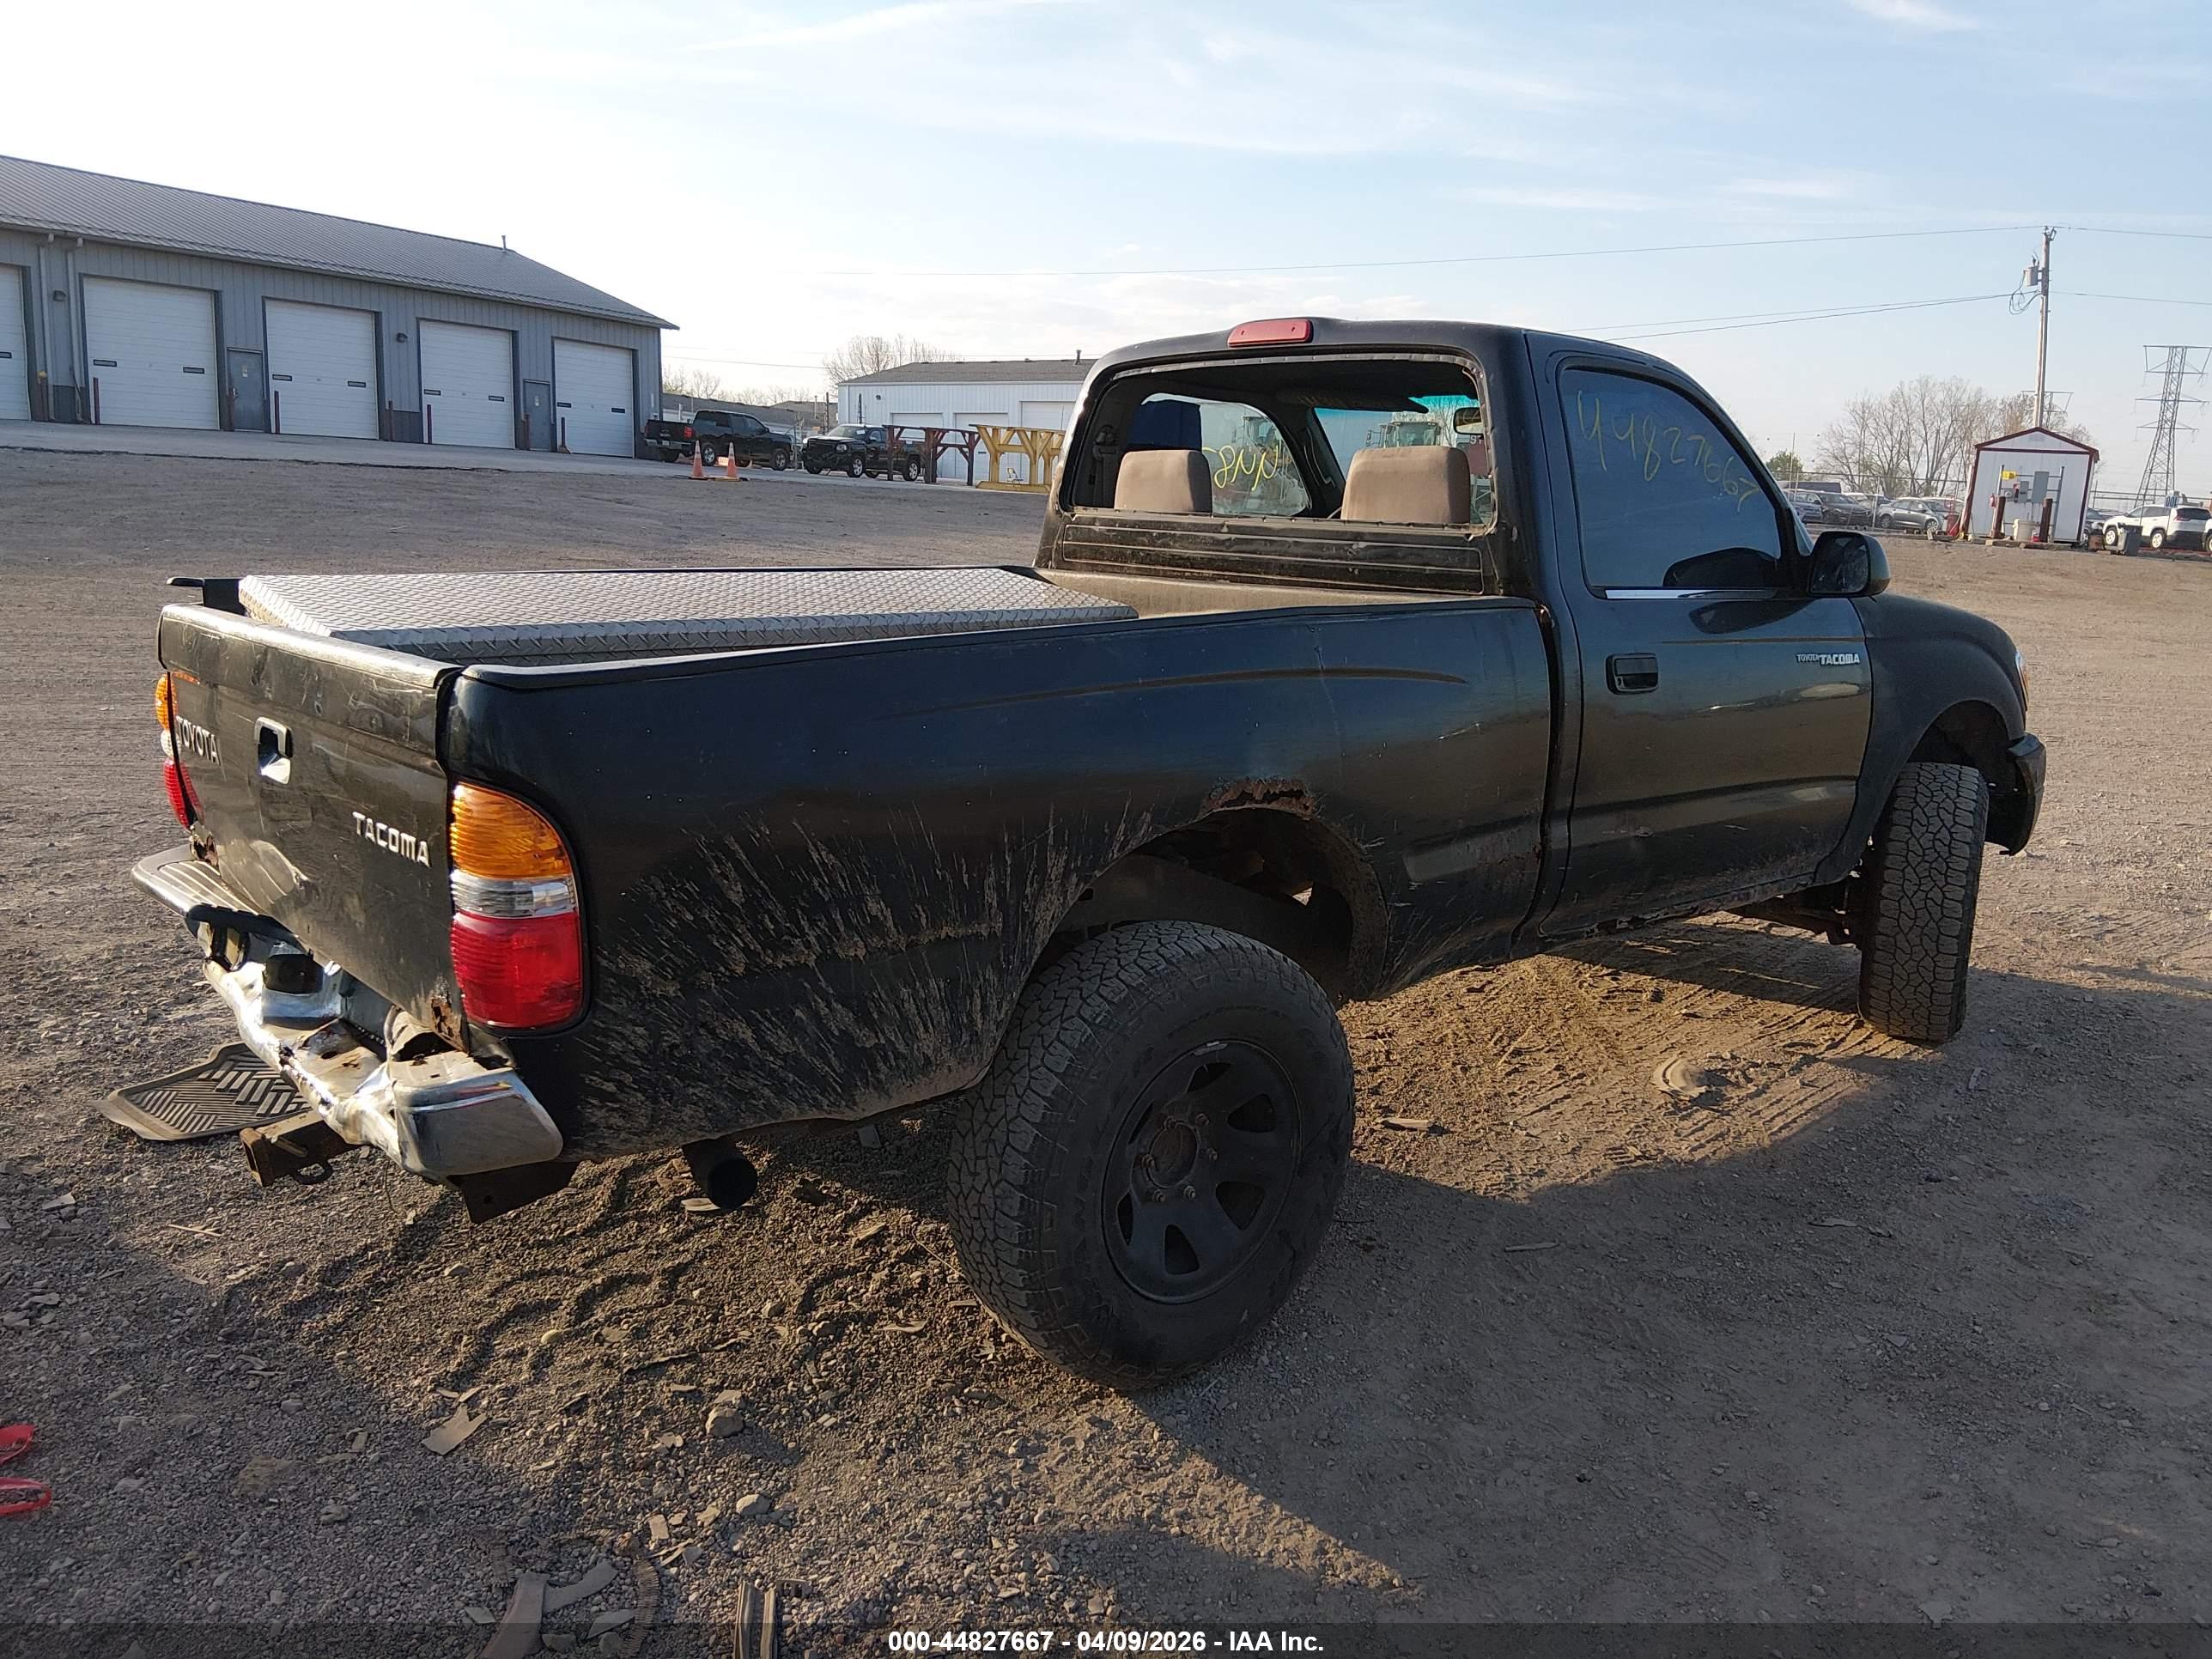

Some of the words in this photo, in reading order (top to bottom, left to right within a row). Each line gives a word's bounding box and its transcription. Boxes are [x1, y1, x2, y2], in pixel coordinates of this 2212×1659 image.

[1577, 390, 1760, 513] 44827667
[1820, 653, 1860, 665] TACOMA
[175, 714, 221, 767] TOYOTA
[352, 811, 431, 870] TACOMA
